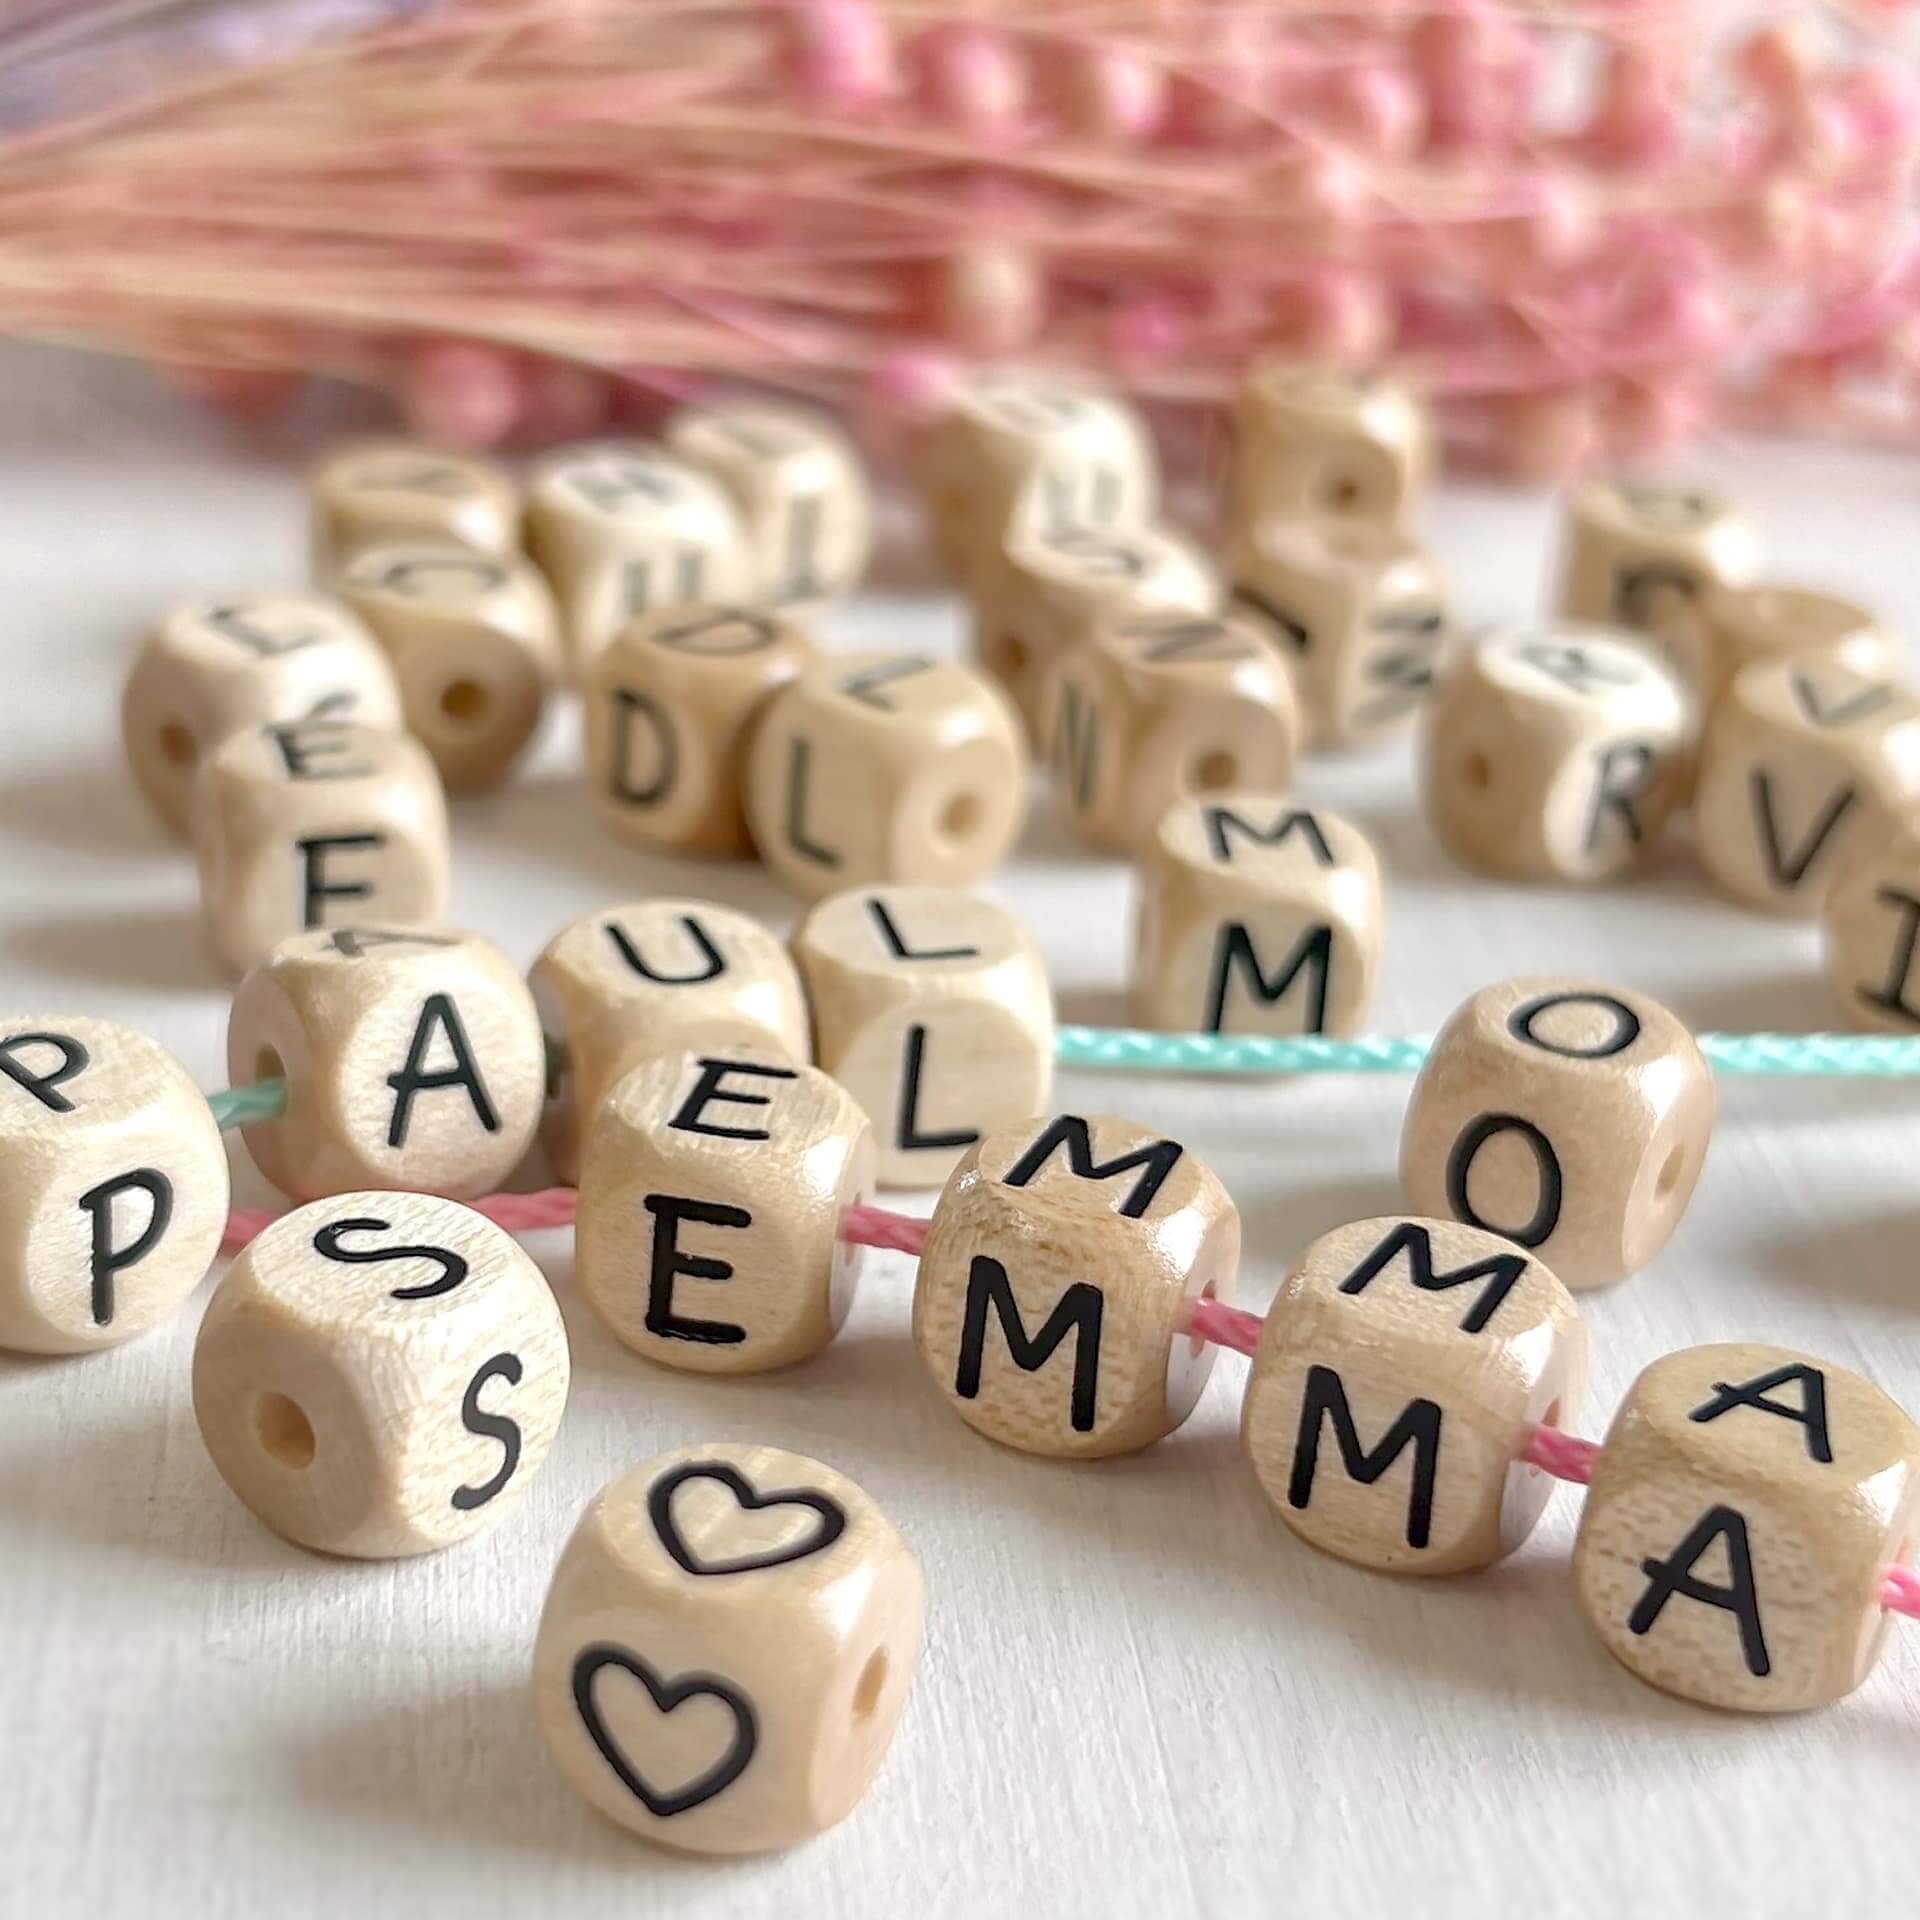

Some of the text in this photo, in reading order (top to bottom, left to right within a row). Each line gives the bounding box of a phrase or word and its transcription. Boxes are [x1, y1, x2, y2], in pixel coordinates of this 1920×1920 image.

[262, 722, 382, 780] E
[607, 686, 682, 812] D
[1792, 668, 1897, 728] V
[784, 735, 846, 866] L
[1205, 806, 1336, 866] M
[1584, 738, 1657, 857] R
[1749, 766, 1862, 892] V
[603, 914, 727, 986] U
[865, 896, 979, 960] L
[1208, 922, 1334, 1034] M
[0, 1031, 92, 1114] P
[386, 992, 502, 1149] A
[1507, 990, 1642, 1059] O
[668, 1055, 801, 1141] E
[898, 1022, 981, 1152] L
[1001, 1114, 1184, 1219] M
[1446, 1110, 1564, 1248] O
[78, 1166, 175, 1327] P
[313, 1216, 471, 1301] S
[643, 1192, 753, 1345] E
[1337, 1222, 1529, 1335] M
[955, 1254, 1105, 1433] M
[450, 1351, 525, 1512] S
[1287, 1363, 1443, 1550] M
[1688, 1361, 1834, 1465] A
[1628, 1503, 1771, 1679] A
